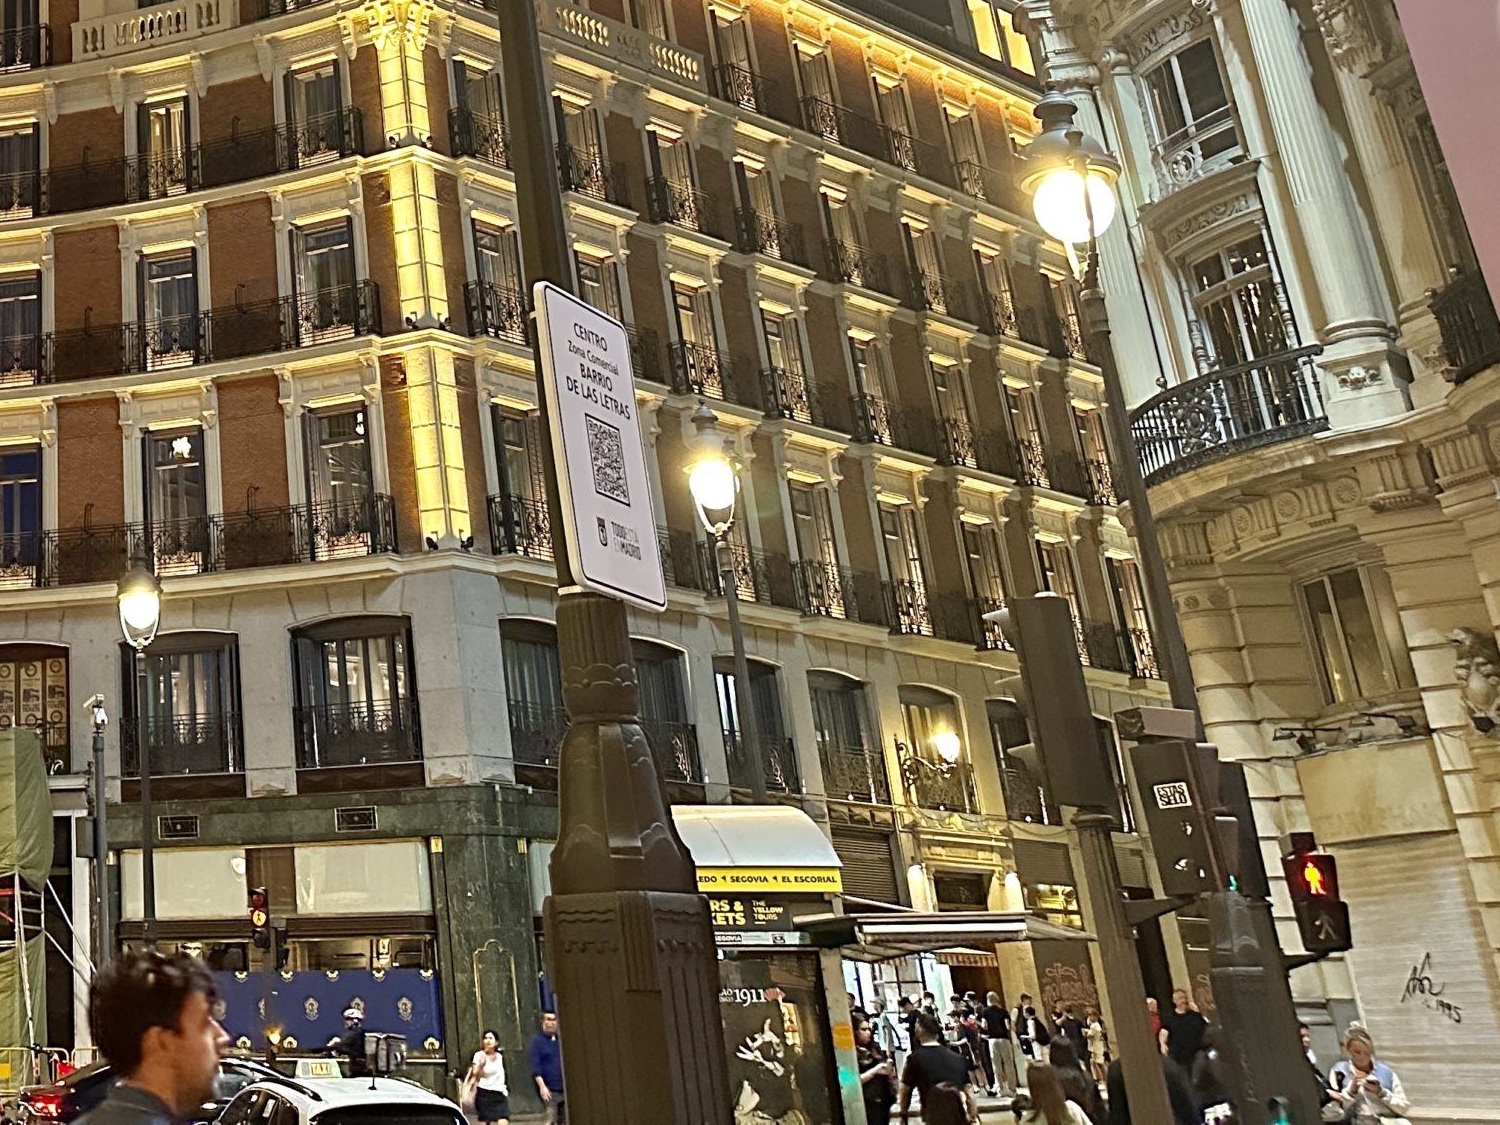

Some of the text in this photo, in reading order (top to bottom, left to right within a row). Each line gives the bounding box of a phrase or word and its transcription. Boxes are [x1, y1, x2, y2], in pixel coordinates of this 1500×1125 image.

[573, 322, 608, 352] CENTRO
[567, 339, 619, 376] Zona Comercial
[580, 362, 613, 392] BARRIO
[566, 375, 631, 420] DE LAS LETRAS
[730, 875, 769, 883] SEGOVIA
[781, 875, 792, 883] EL
[794, 875, 837, 883] ESCORIAL
[752, 906, 784, 914] YELLOW
[733, 988, 767, 1007] 1911
